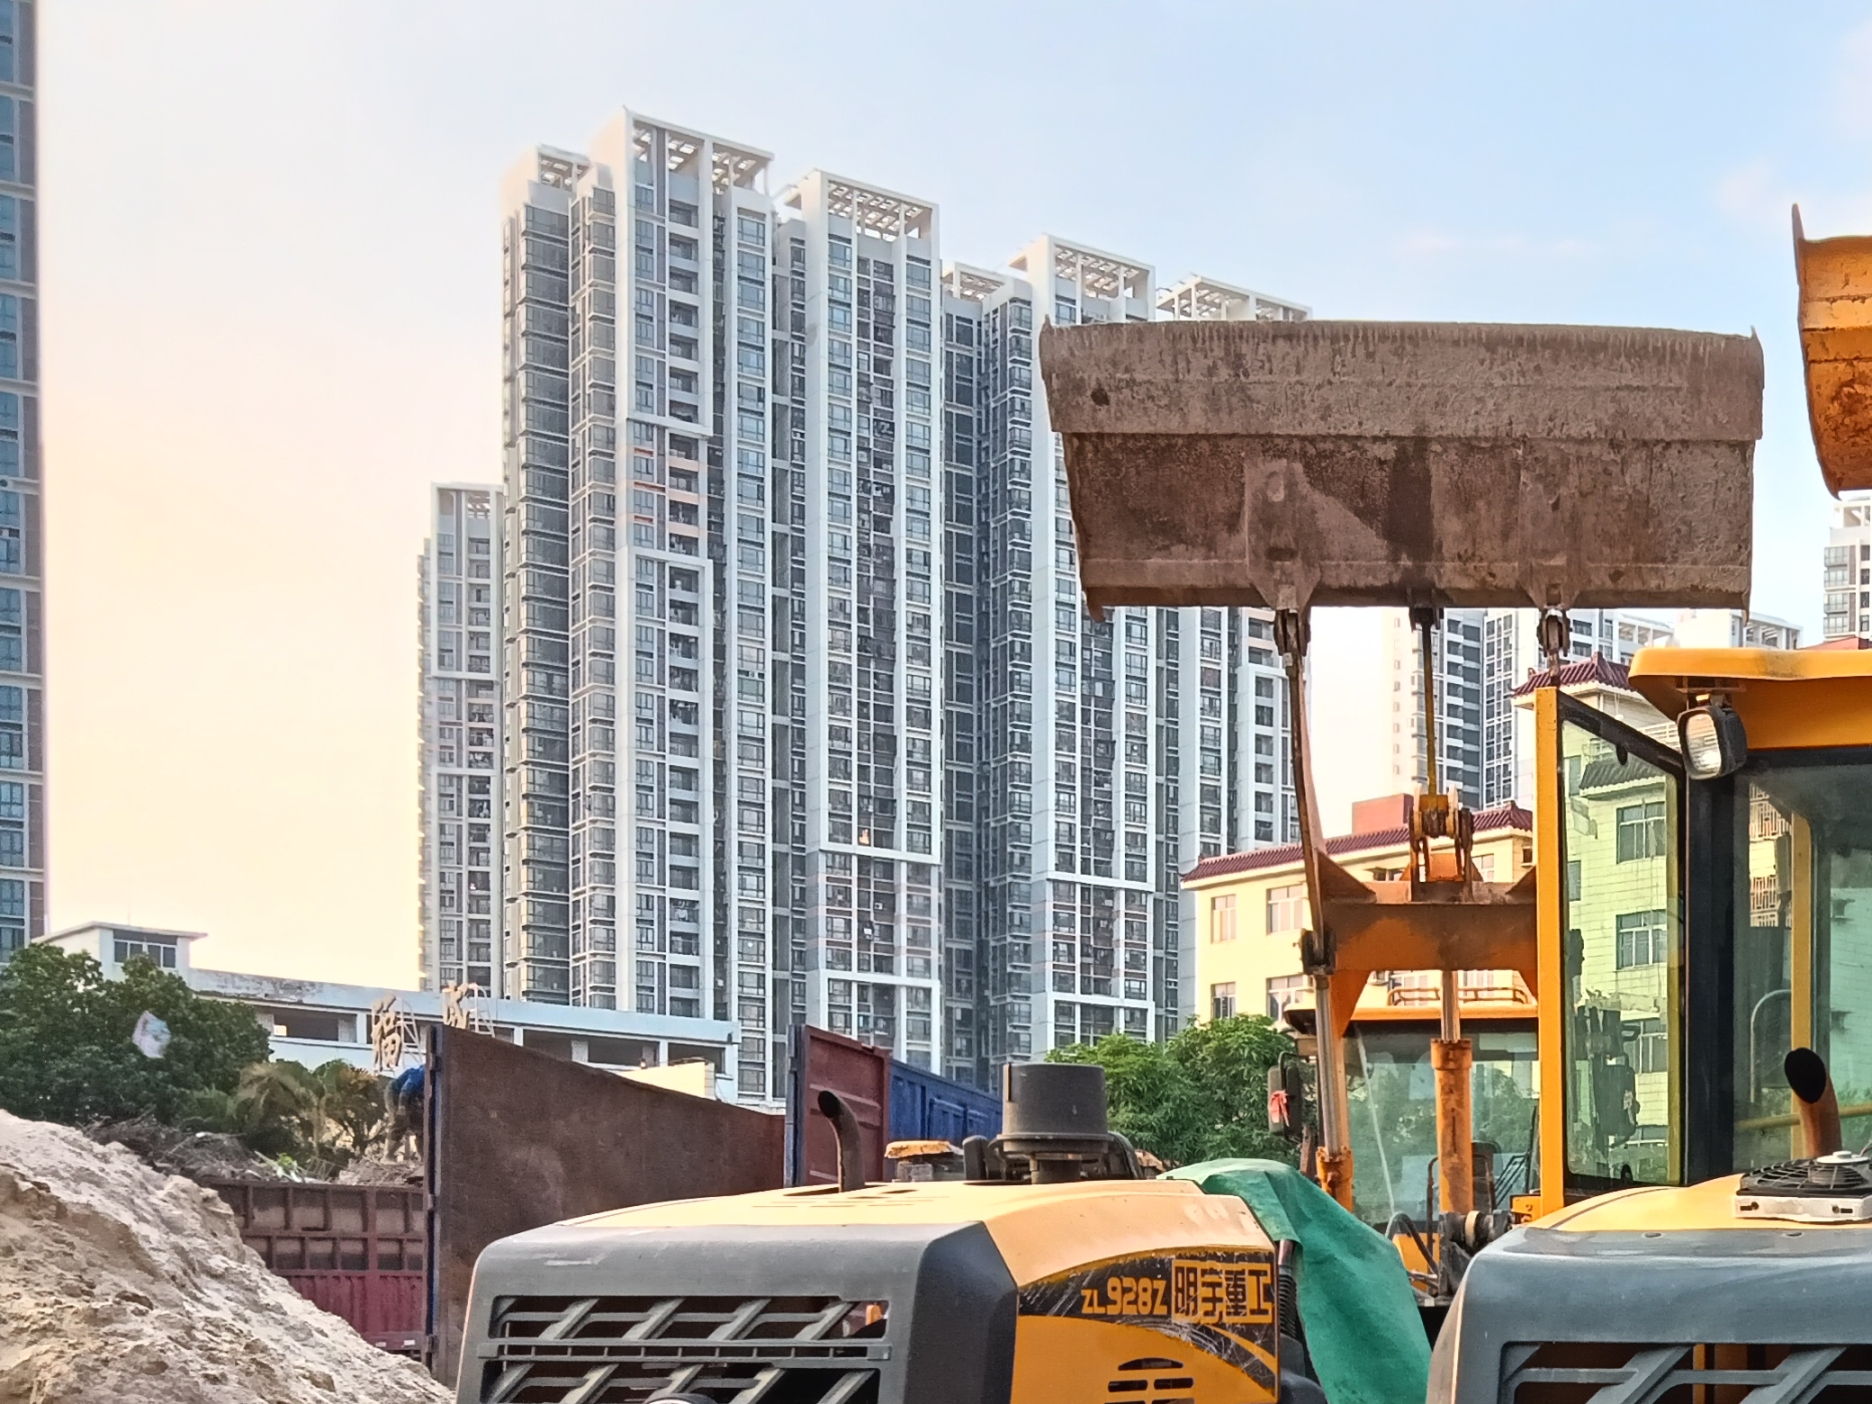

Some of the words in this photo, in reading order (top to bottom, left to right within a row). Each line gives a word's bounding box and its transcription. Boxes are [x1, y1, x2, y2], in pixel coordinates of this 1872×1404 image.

[1081, 1277, 1167, 1315] ZL928Z
[1174, 1264, 1270, 1317] 明宇重工
